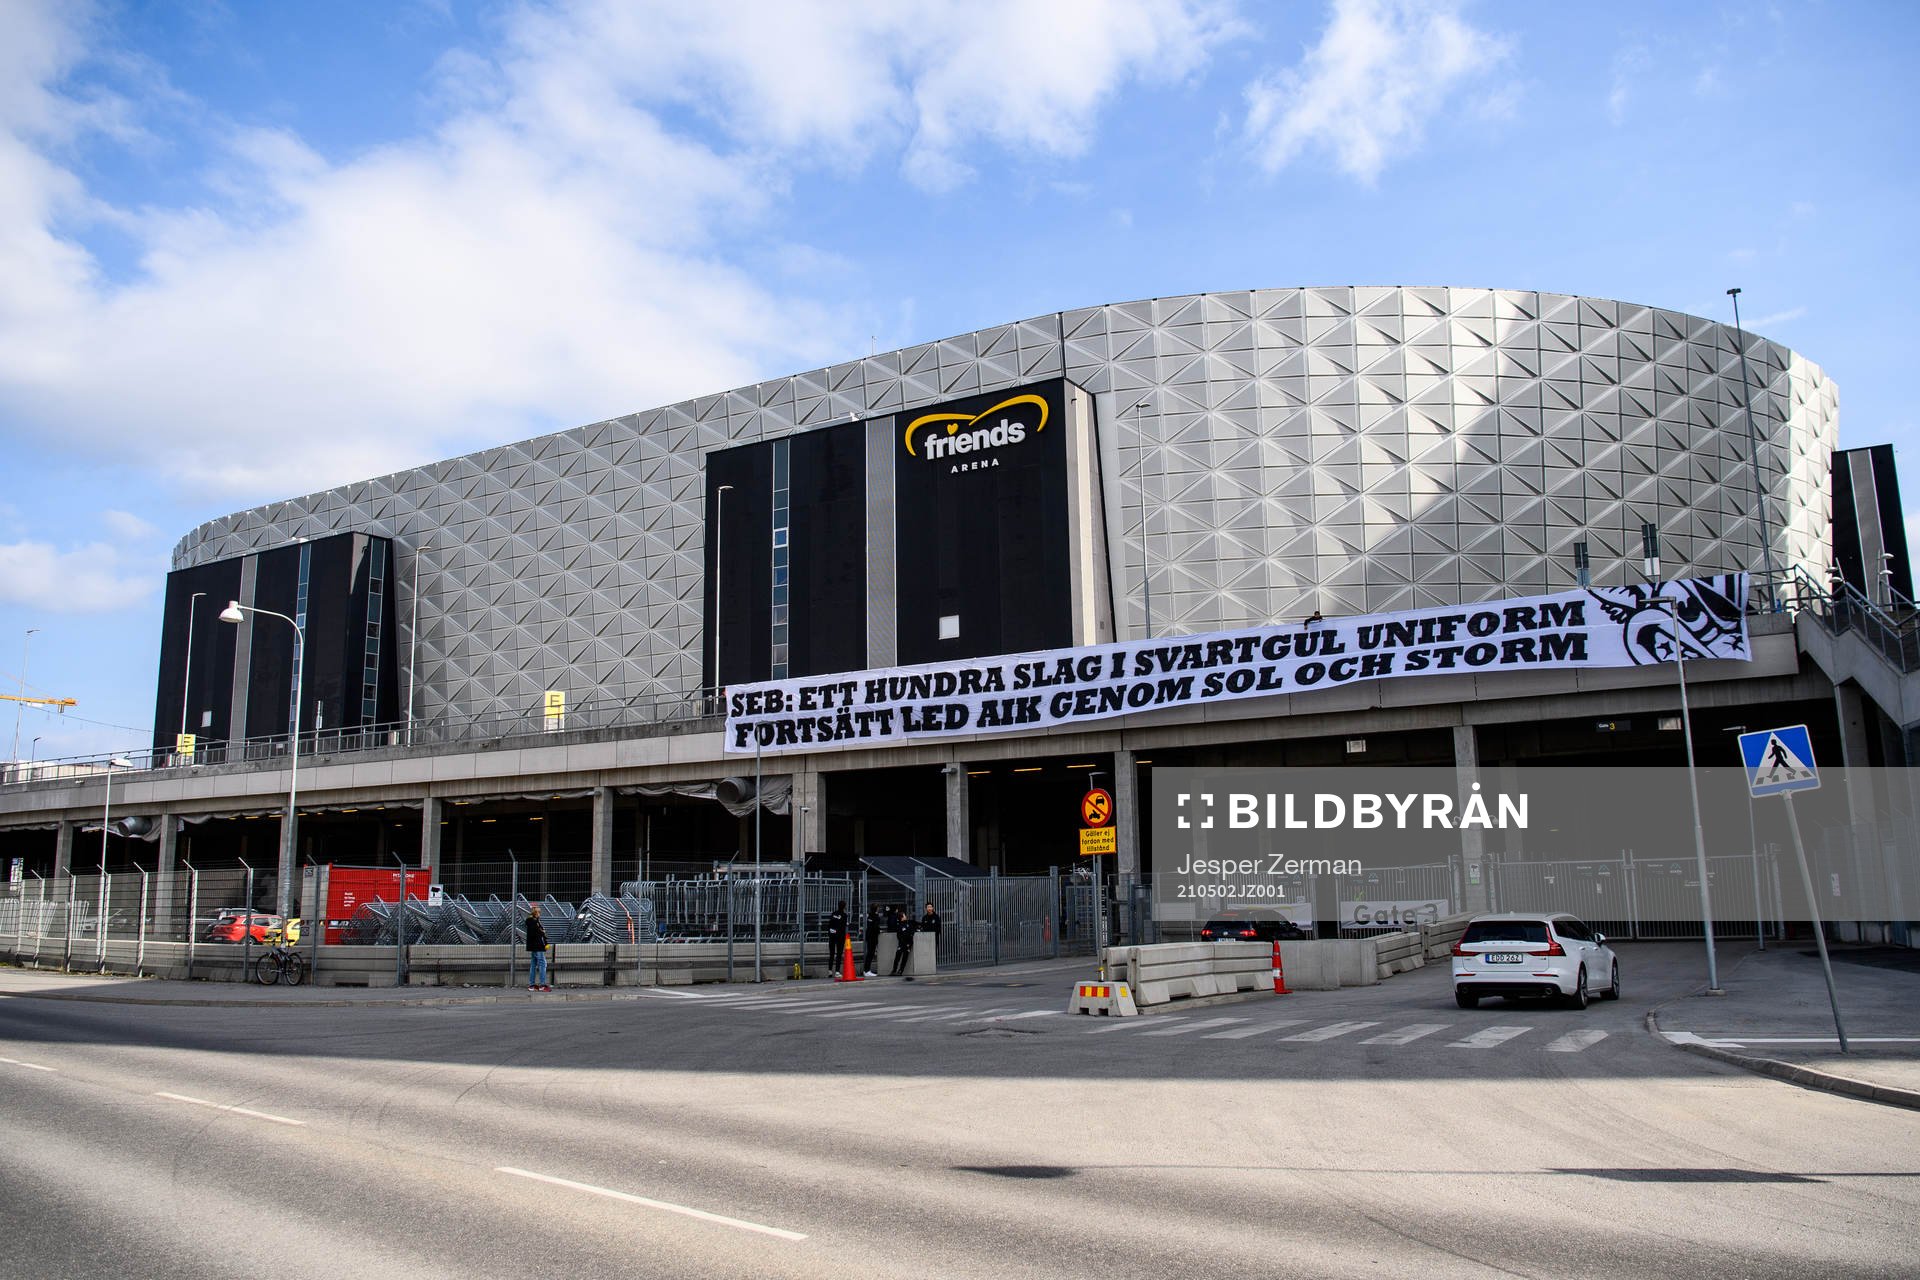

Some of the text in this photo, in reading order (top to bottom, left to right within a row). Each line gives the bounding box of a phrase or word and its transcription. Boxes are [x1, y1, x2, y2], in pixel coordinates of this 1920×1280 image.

[924, 418, 1026, 460] friends
[951, 458, 999, 474] ARENA
[731, 600, 1586, 718] SEB: ETT HUNDRA SLAG I SVARTGUL UNIFORM
[735, 633, 1588, 748] FORTSÄTT LED AIK GENOM SOL OCH STORM
[1353, 903, 1439, 925] Gate 3
